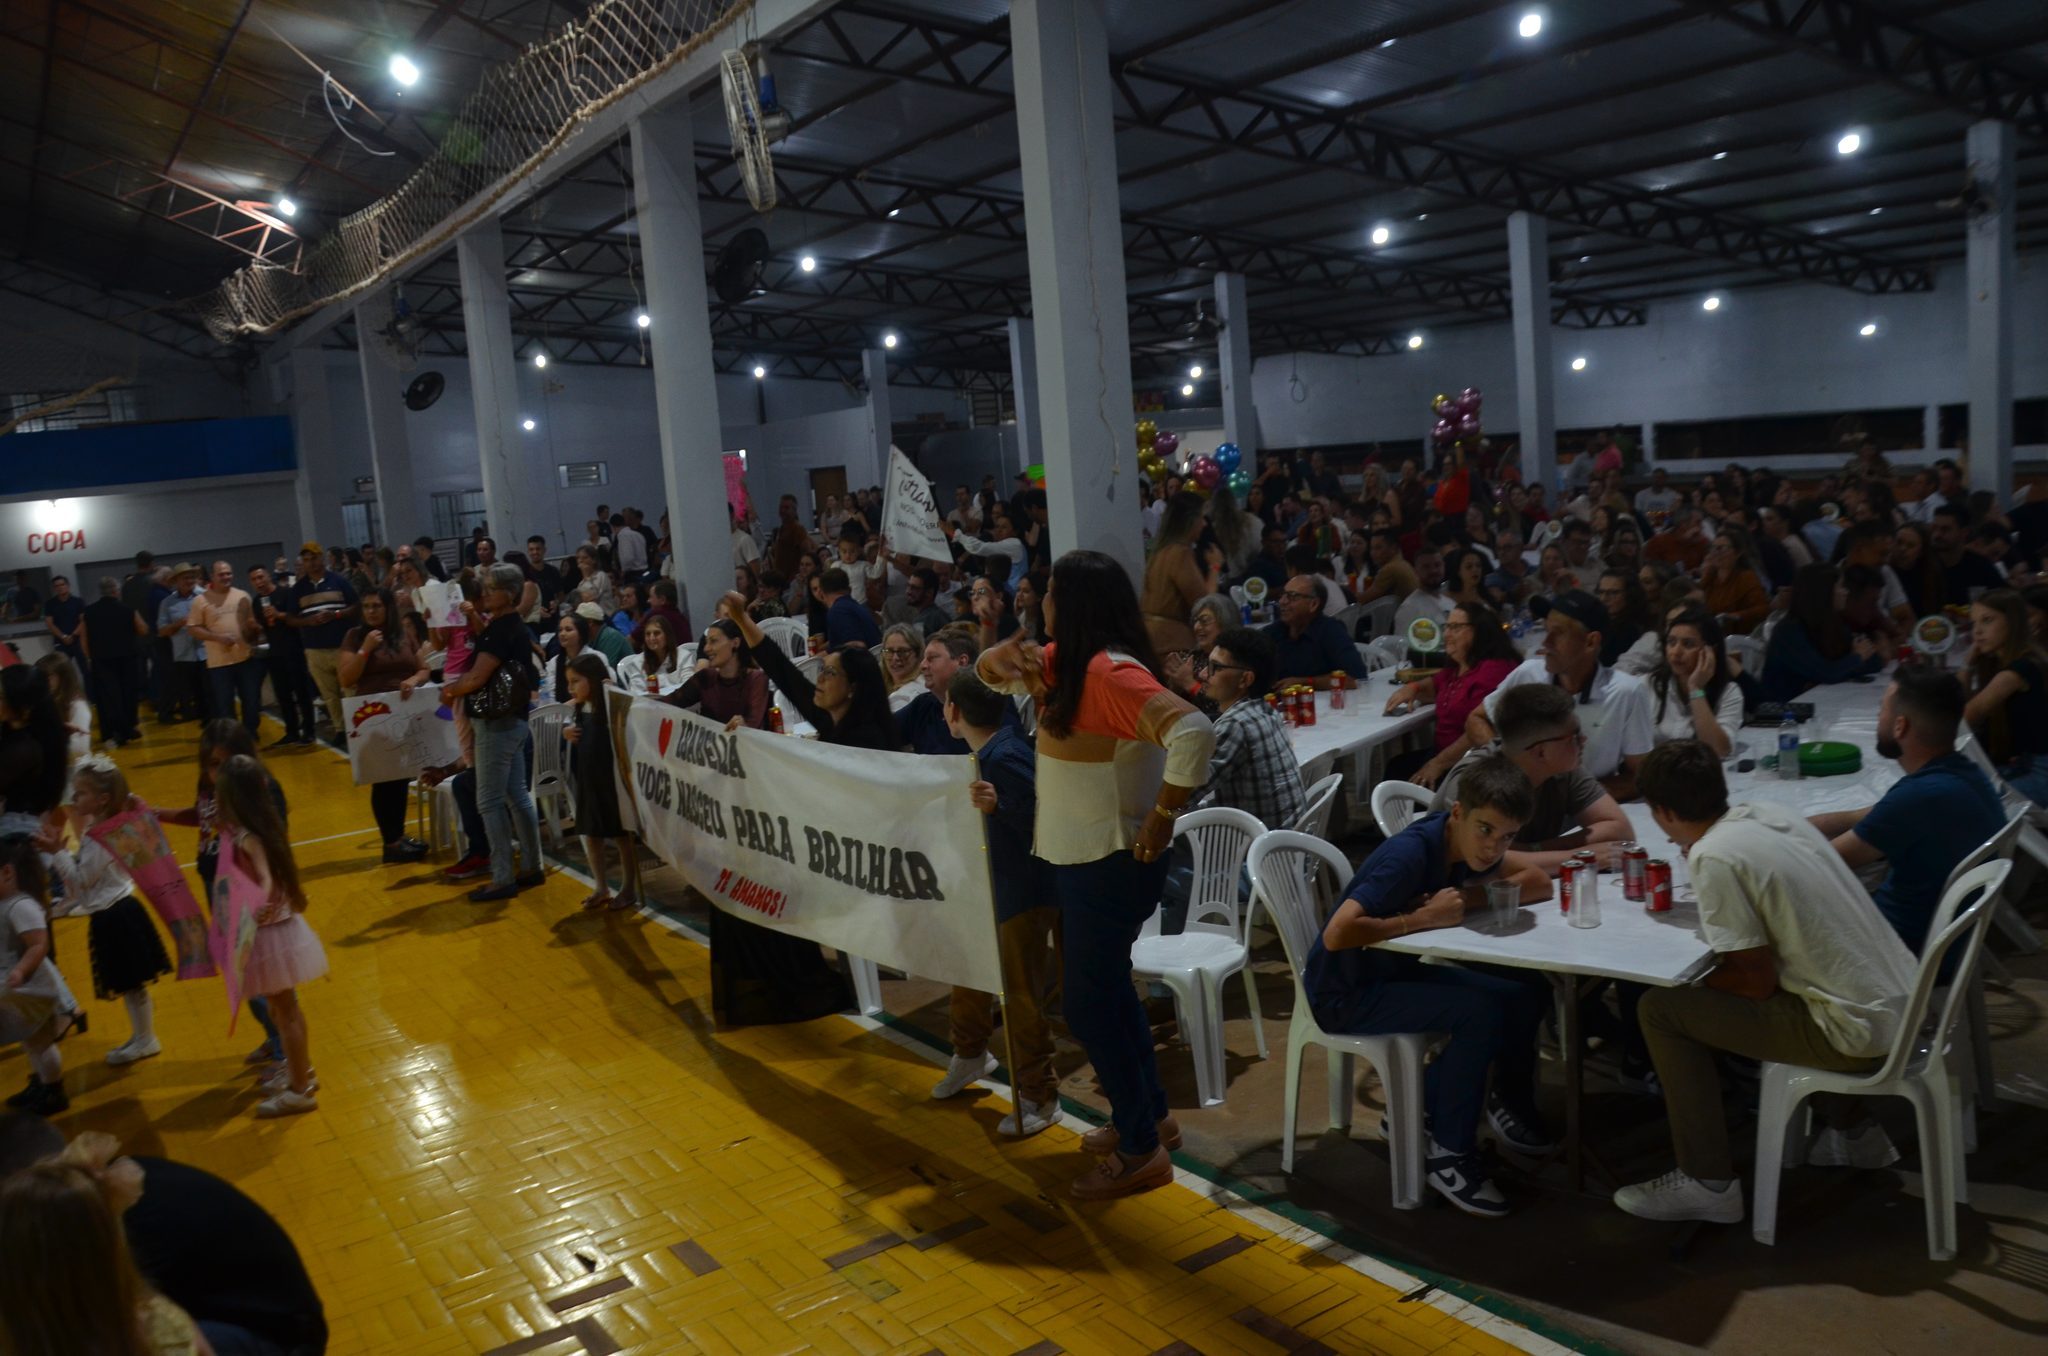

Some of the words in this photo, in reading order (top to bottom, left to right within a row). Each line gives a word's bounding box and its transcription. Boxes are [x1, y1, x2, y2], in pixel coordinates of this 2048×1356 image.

[28, 529, 87, 554] COPA
[675, 778, 728, 840] NASCEU
[732, 804, 796, 864] PARA
[803, 825, 945, 902] BRILHAR
[714, 868, 732, 893] TE
